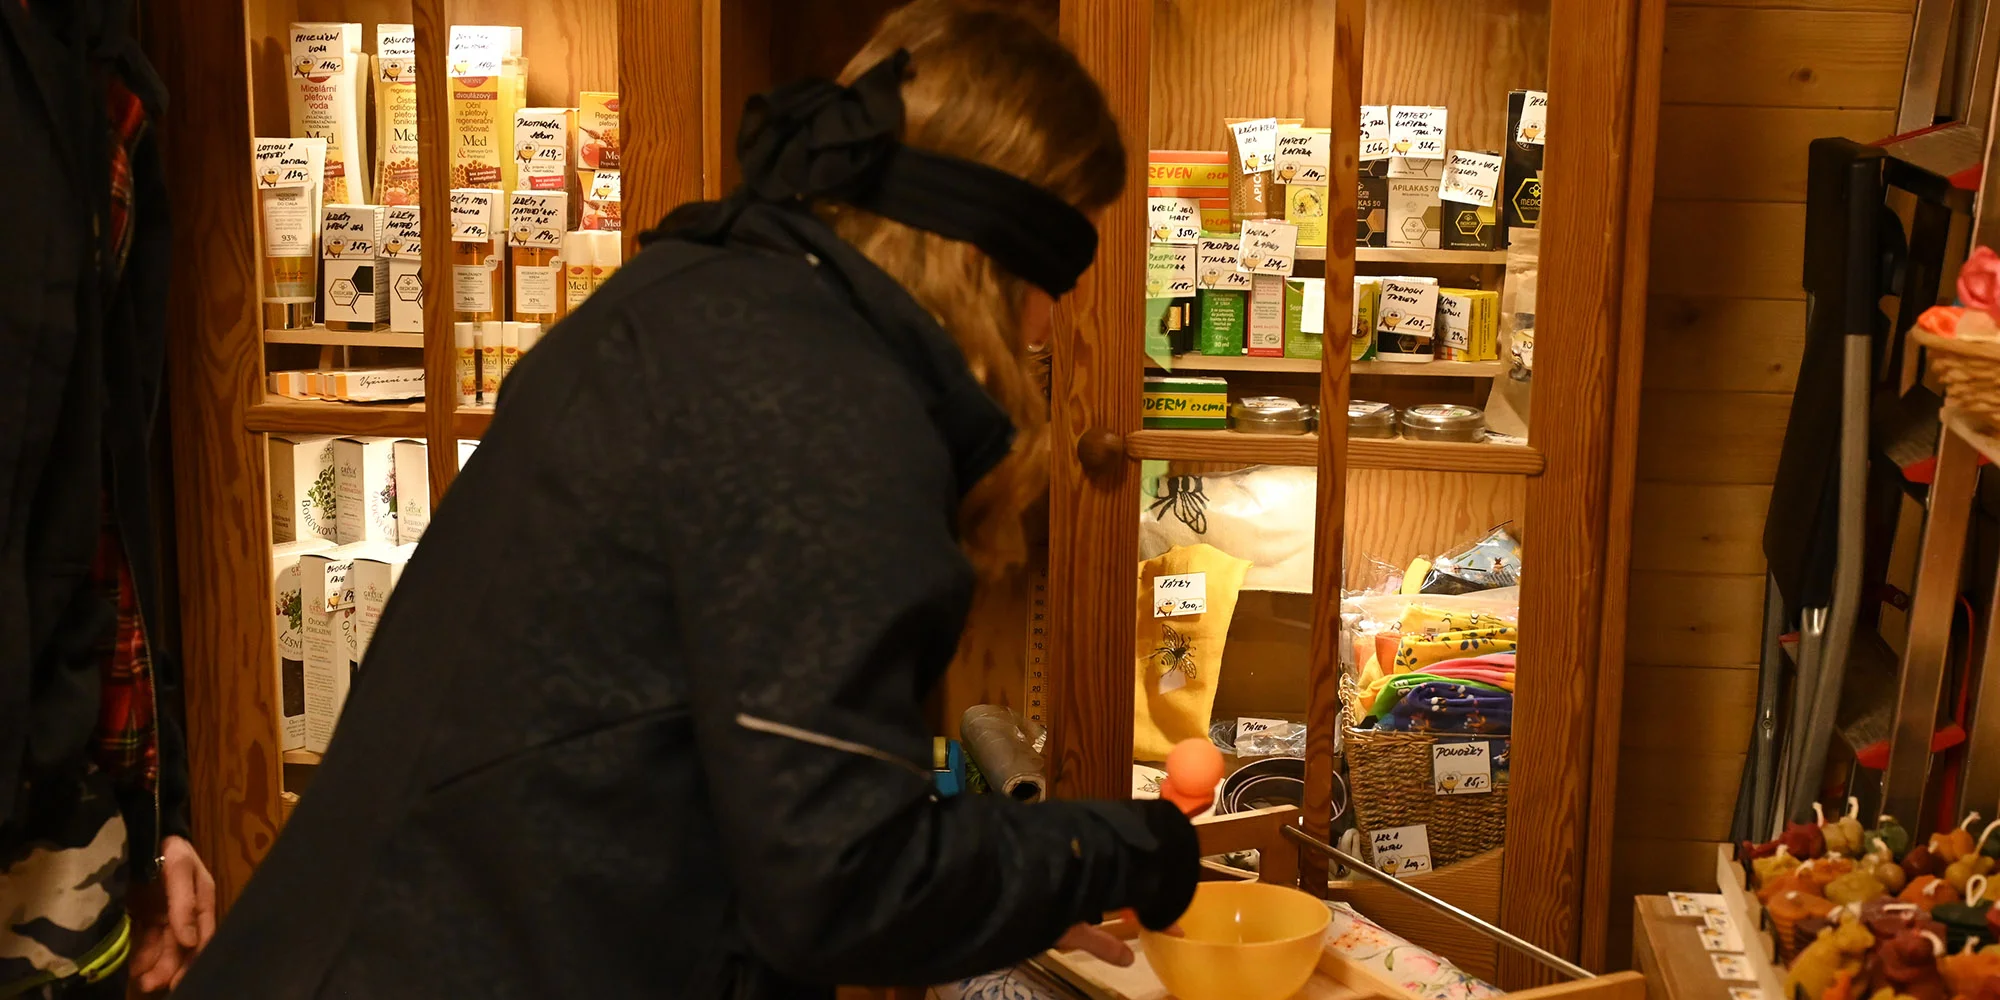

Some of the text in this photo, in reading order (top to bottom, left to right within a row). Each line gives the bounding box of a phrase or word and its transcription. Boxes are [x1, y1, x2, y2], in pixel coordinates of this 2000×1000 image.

[300, 84, 336, 93] Micelární
[463, 135, 487, 147] Med
[568, 281, 588, 291] Med
[1435, 744, 1483, 758] PONOŽKY
